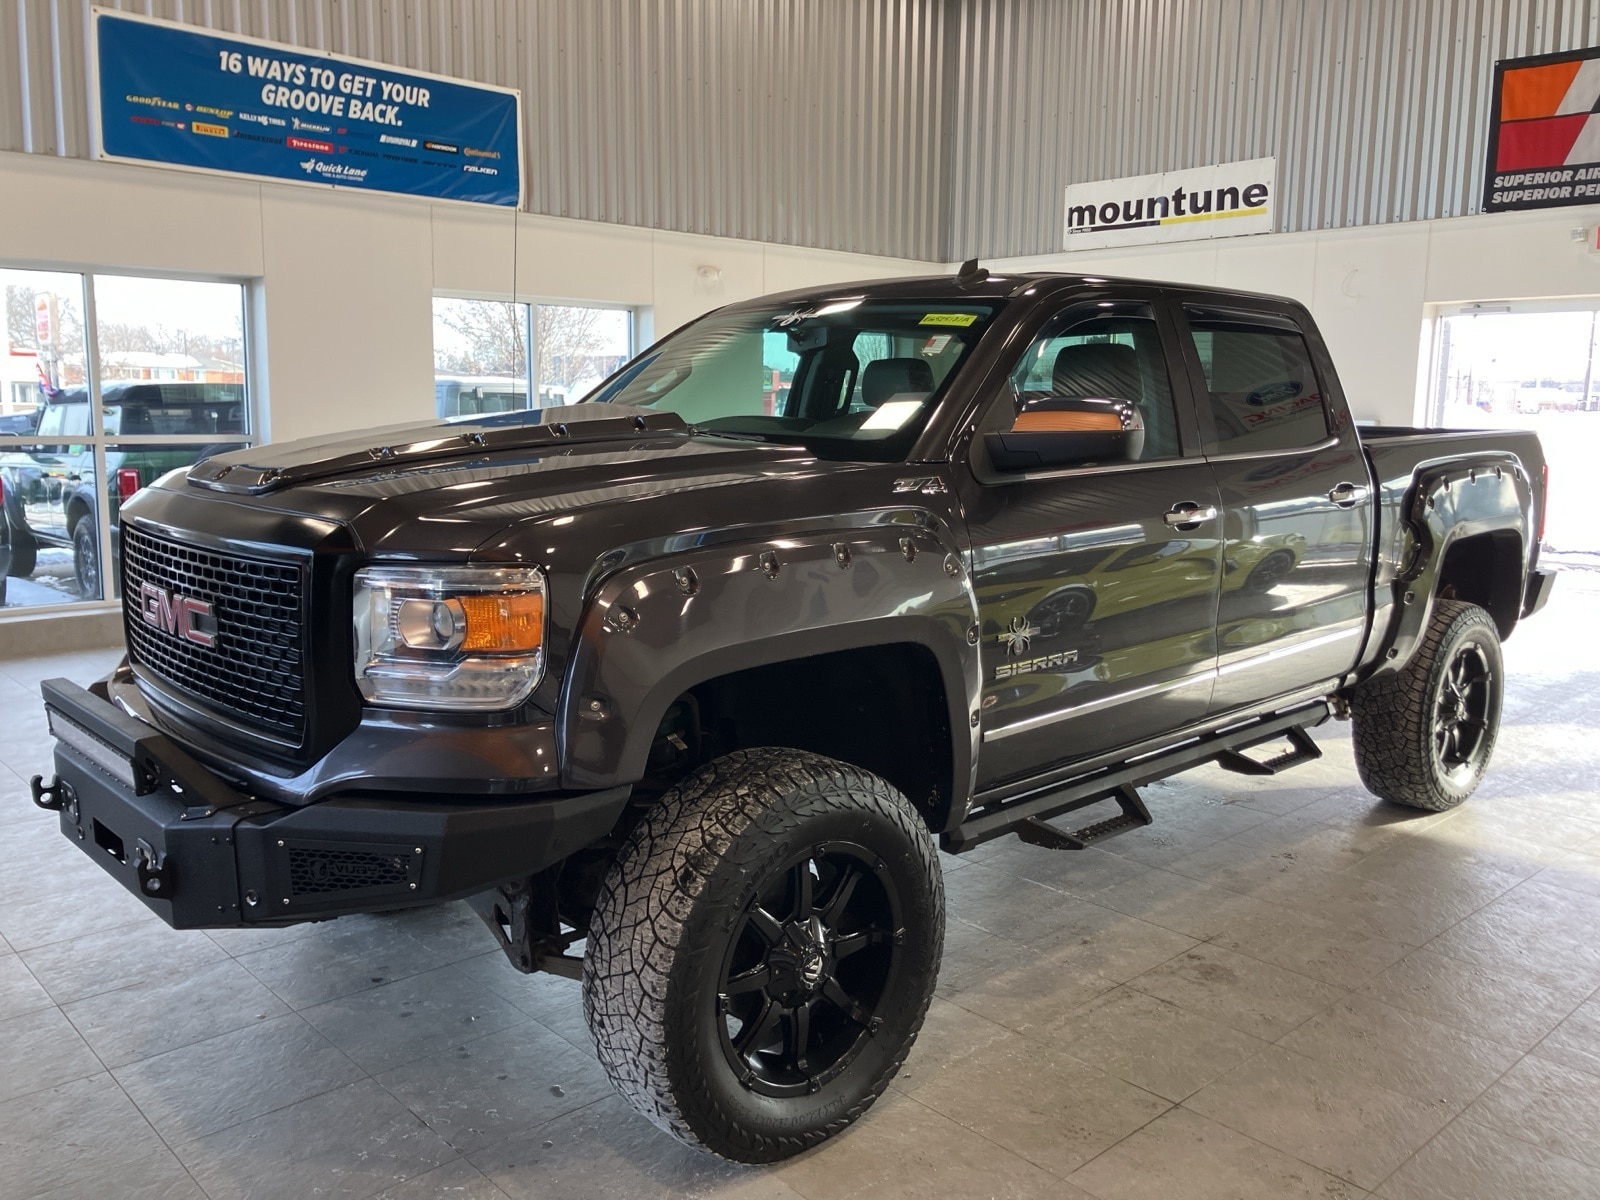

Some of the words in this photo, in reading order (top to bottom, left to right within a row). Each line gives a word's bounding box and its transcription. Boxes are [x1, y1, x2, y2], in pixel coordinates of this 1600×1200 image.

[219, 51, 243, 74] 16
[247, 55, 306, 86] WAYS
[309, 67, 335, 90] TO
[338, 73, 377, 98] GET
[380, 81, 431, 108] YOUR
[126, 94, 180, 110] GOODYEAR
[261, 84, 346, 117] GROOVE
[348, 99, 404, 127] BACK.
[196, 105, 234, 119] DUNLOP
[300, 122, 331, 133] MICHELIN
[291, 139, 330, 151] Firestone
[315, 161, 342, 174] Quick
[343, 165, 367, 177] Lane
[463, 164, 498, 175] FALKEN
[1493, 170, 1574, 188] SUPERIOR
[1491, 186, 1572, 204] SUPERIOR
[1068, 183, 1269, 228] mountune
[141, 580, 216, 648] GMC
[995, 649, 1078, 679] SIERRA
